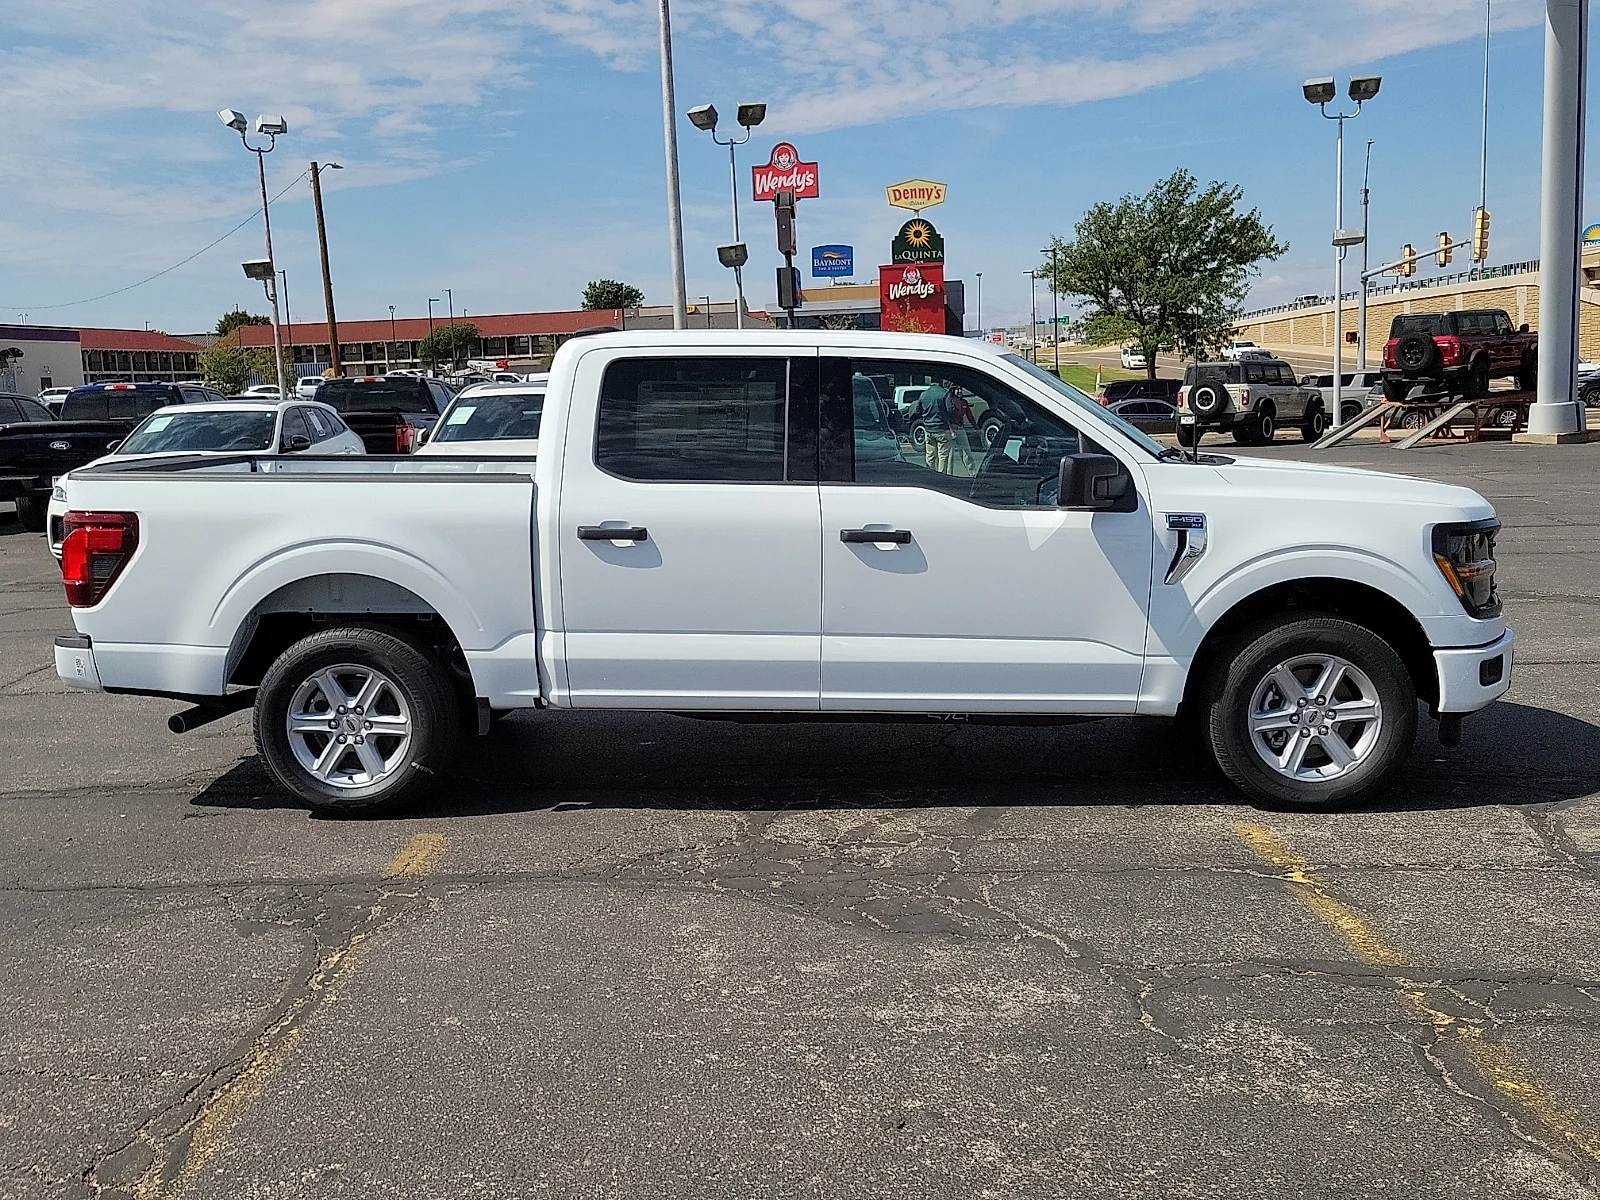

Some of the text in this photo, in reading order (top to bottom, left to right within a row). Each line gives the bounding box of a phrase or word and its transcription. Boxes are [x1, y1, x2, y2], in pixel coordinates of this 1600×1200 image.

[755, 167, 815, 195] Wendy's
[892, 186, 942, 201] Denny's
[813, 259, 852, 267] BAYMONT
[902, 250, 943, 261] QUINTA
[889, 279, 935, 300] Wendy's
